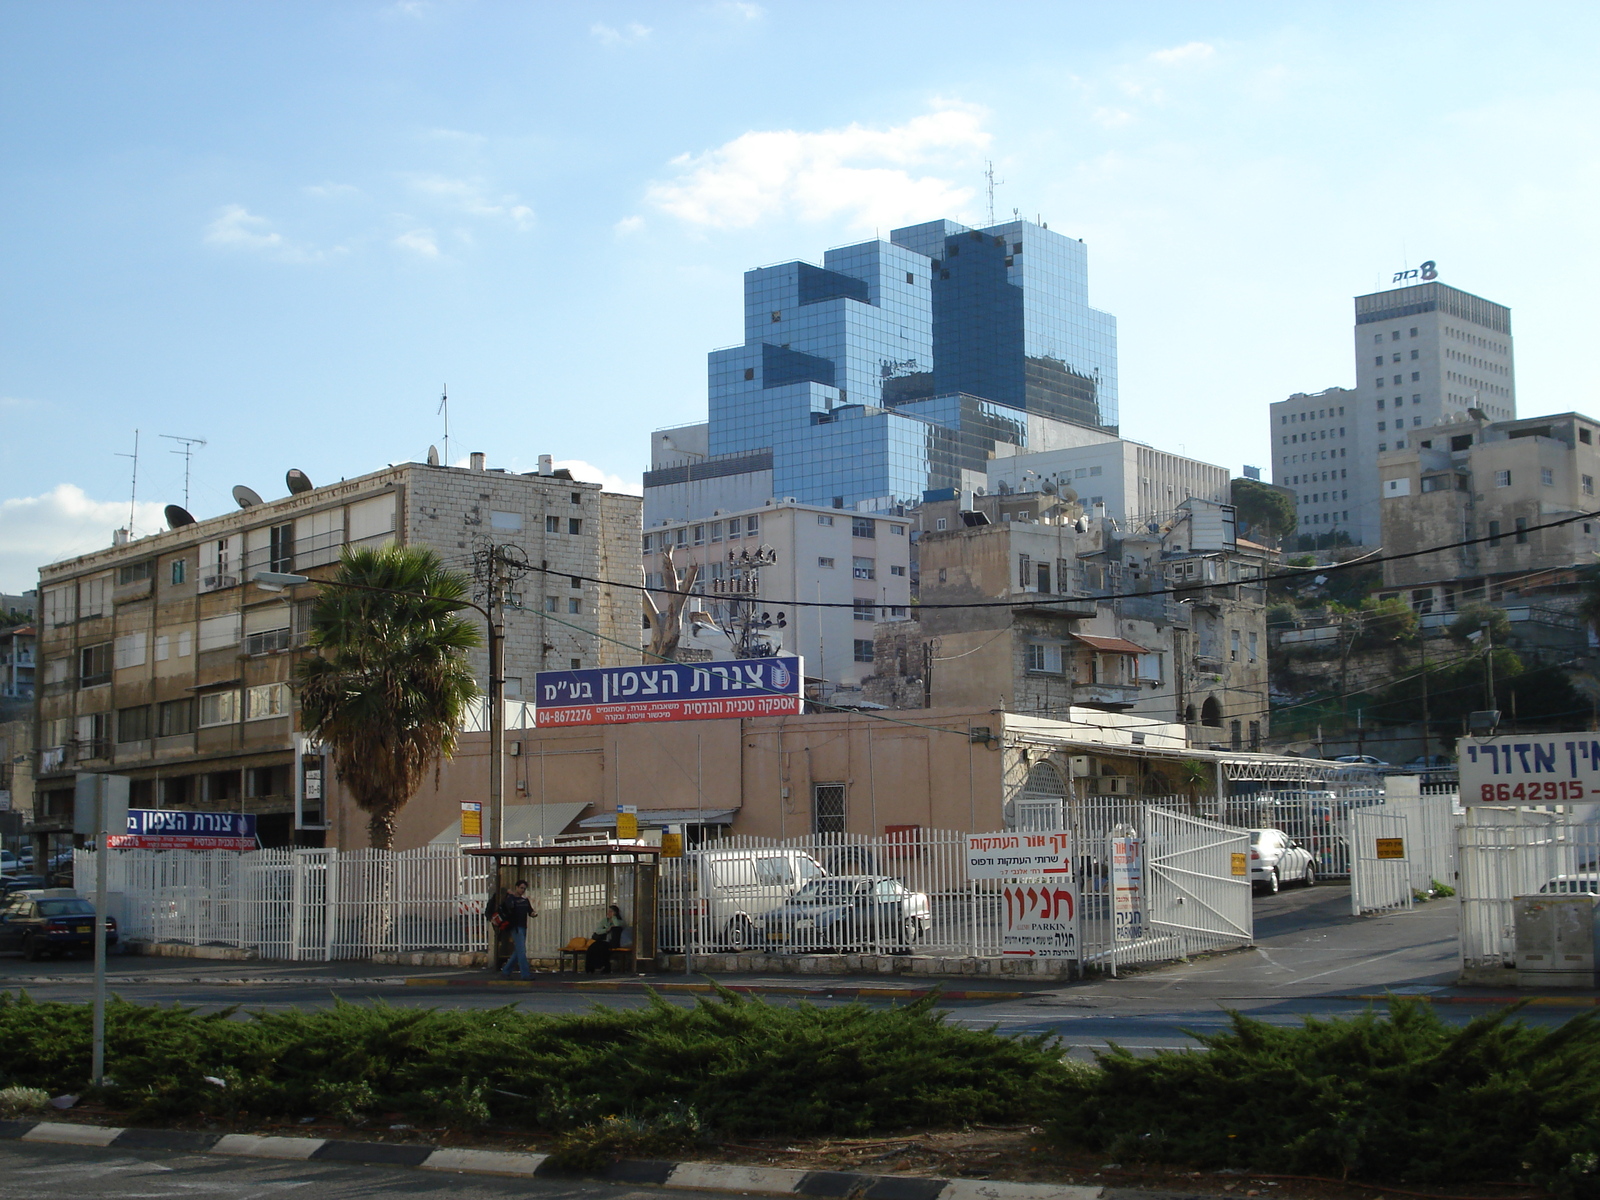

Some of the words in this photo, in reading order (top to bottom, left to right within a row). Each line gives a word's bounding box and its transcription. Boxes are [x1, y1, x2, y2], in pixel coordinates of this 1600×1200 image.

[1393, 269, 1419, 283] בזק
[602, 669, 678, 702] הצפון
[690, 664, 763, 692] צנרת
[544, 680, 592, 700] בע"מ
[683, 701, 722, 715] והנדסית
[726, 700, 755, 713] טכנית
[758, 697, 795, 714] אספקה
[540, 709, 592, 723] 04-8672276
[1467, 743, 1556, 774] אזורי
[1481, 781, 1583, 801] 8642915
[142, 812, 187, 834] הצפון
[193, 814, 231, 832] צנרת
[970, 836, 1019, 852] העתקות
[1023, 835, 1046, 848] אור
[1050, 834, 1068, 854] דף
[971, 858, 994, 866] ודפוס
[997, 856, 1031, 866] העתקות
[1034, 855, 1058, 863] שרותי
[1004, 886, 1074, 932] חניון
[1117, 911, 1141, 924] חניה
[1055, 932, 1075, 947] חניה
